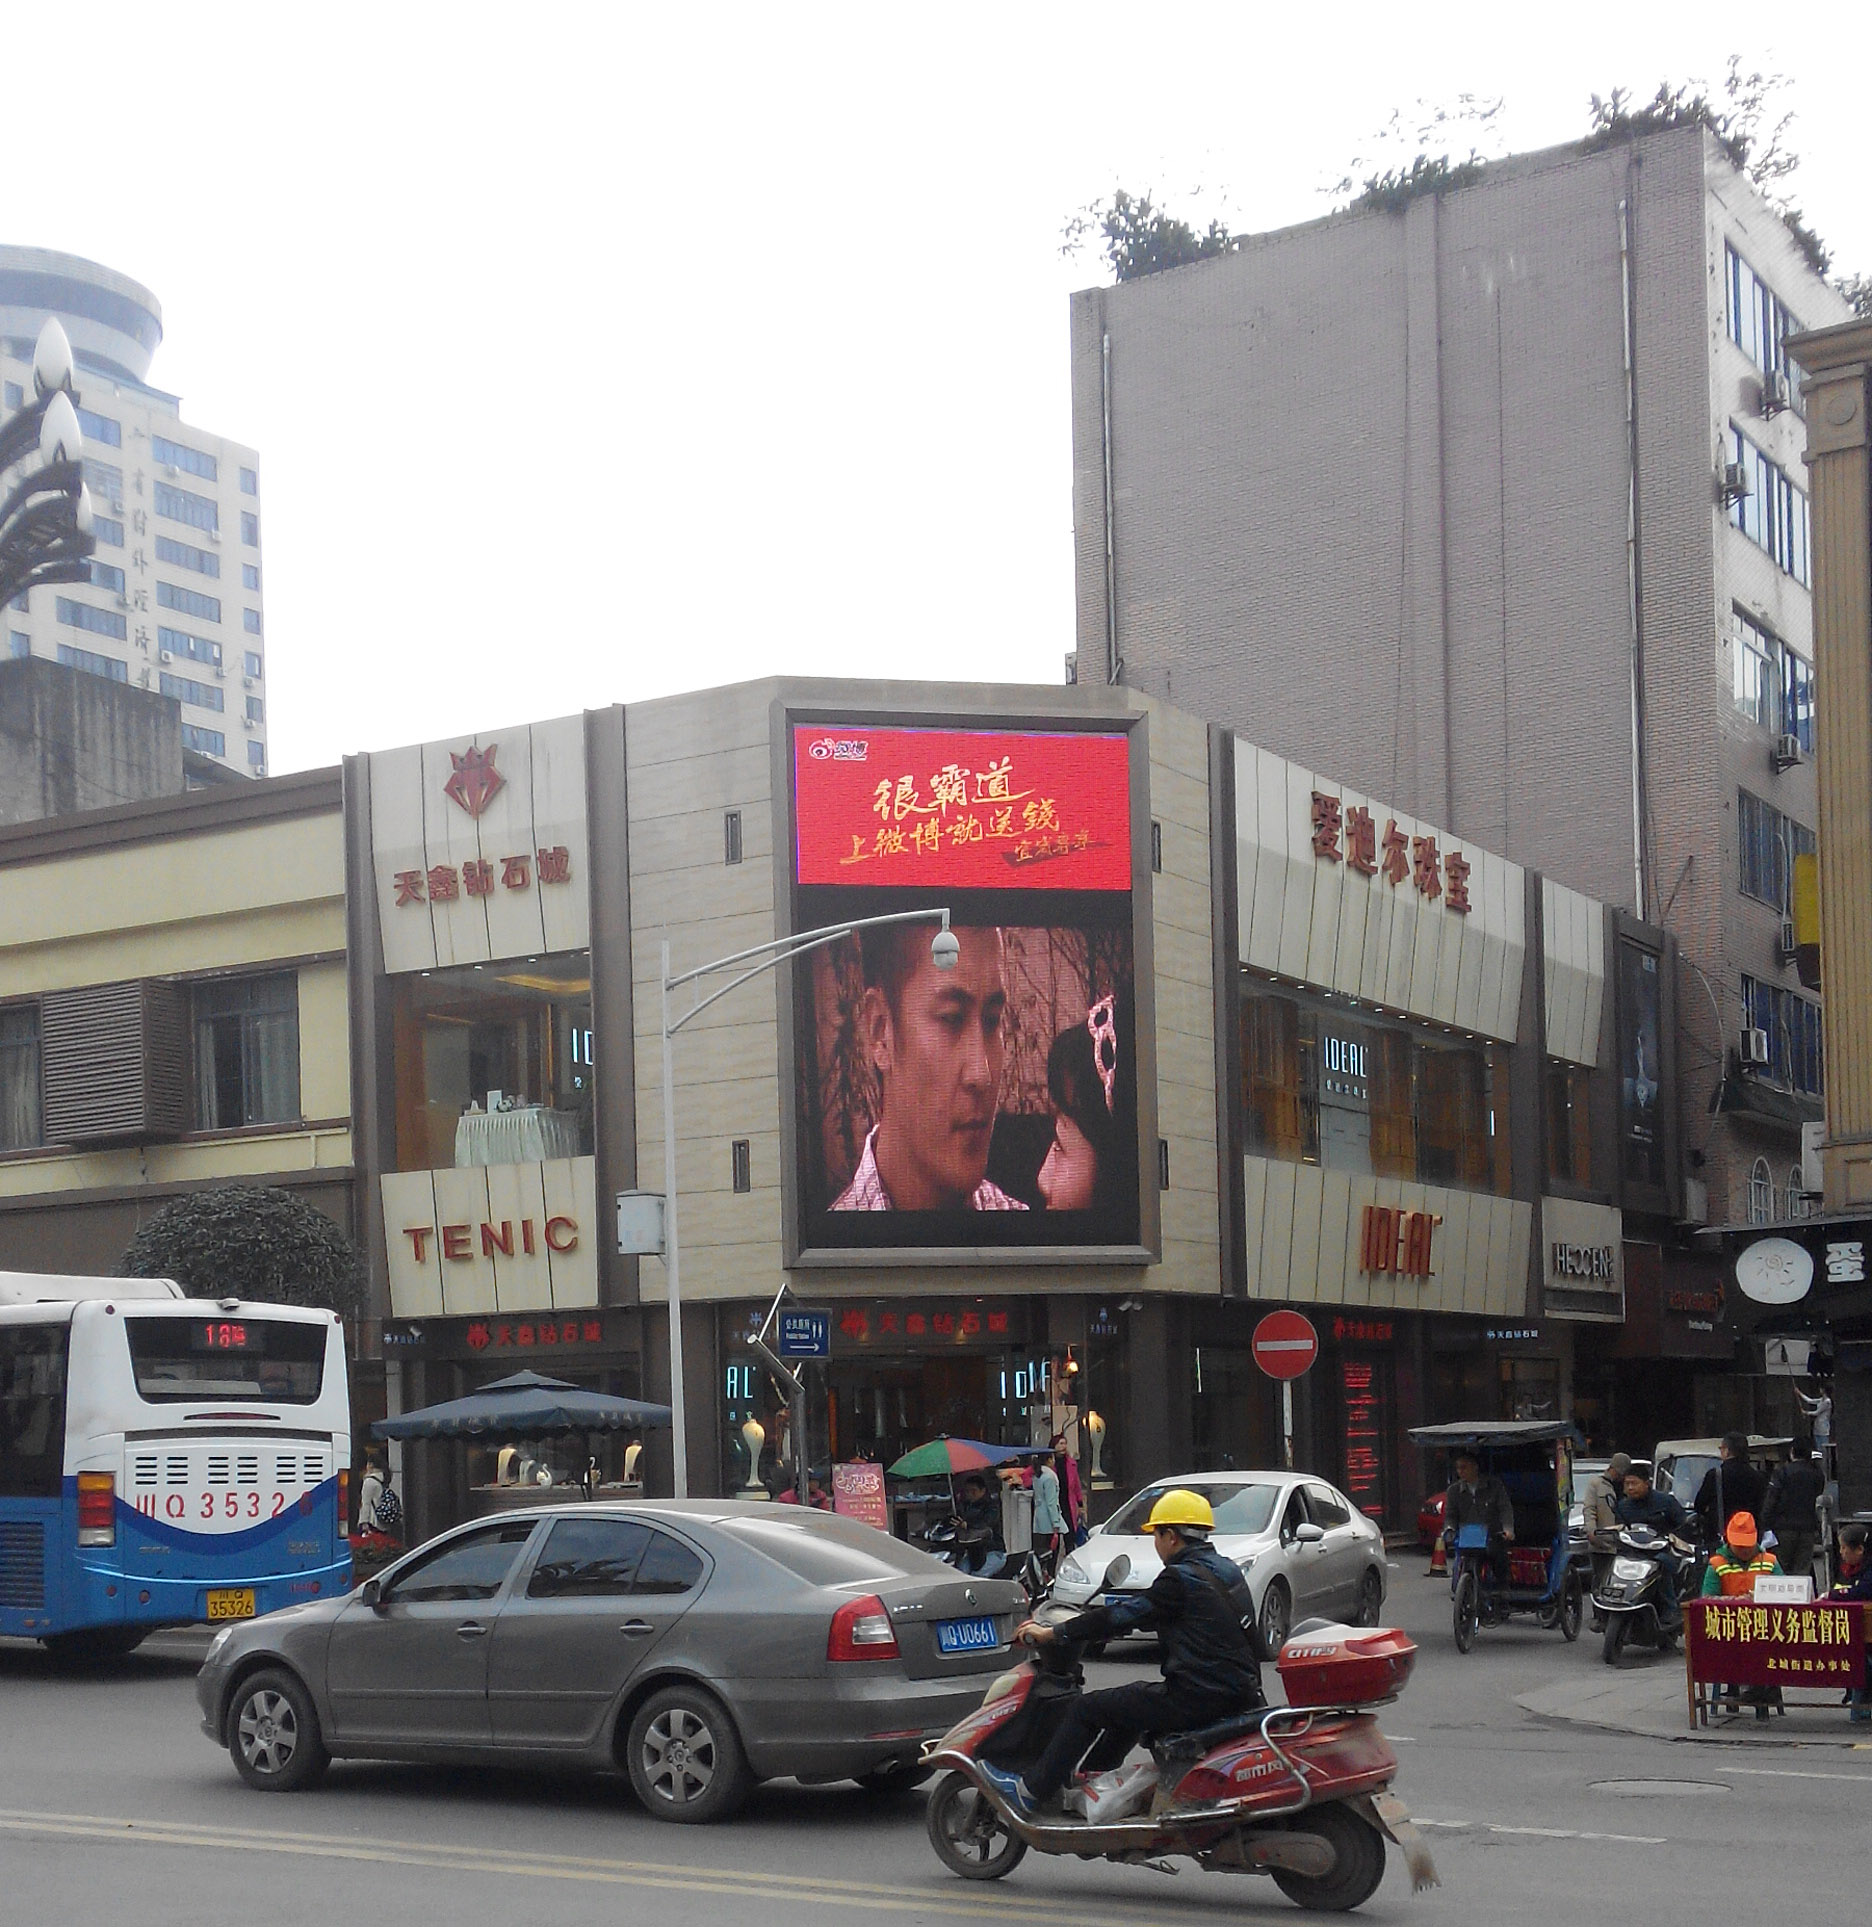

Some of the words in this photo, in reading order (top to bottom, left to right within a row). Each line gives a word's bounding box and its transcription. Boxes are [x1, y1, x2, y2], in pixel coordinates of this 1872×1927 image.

[872, 756, 1036, 821] 很霸道
[394, 846, 571, 906] 天鑫钻石城
[402, 1216, 579, 1263] TENIC
[210, 1600, 254, 1617] 35326
[1705, 1605, 1850, 1645] 城市管理义务监督岗
